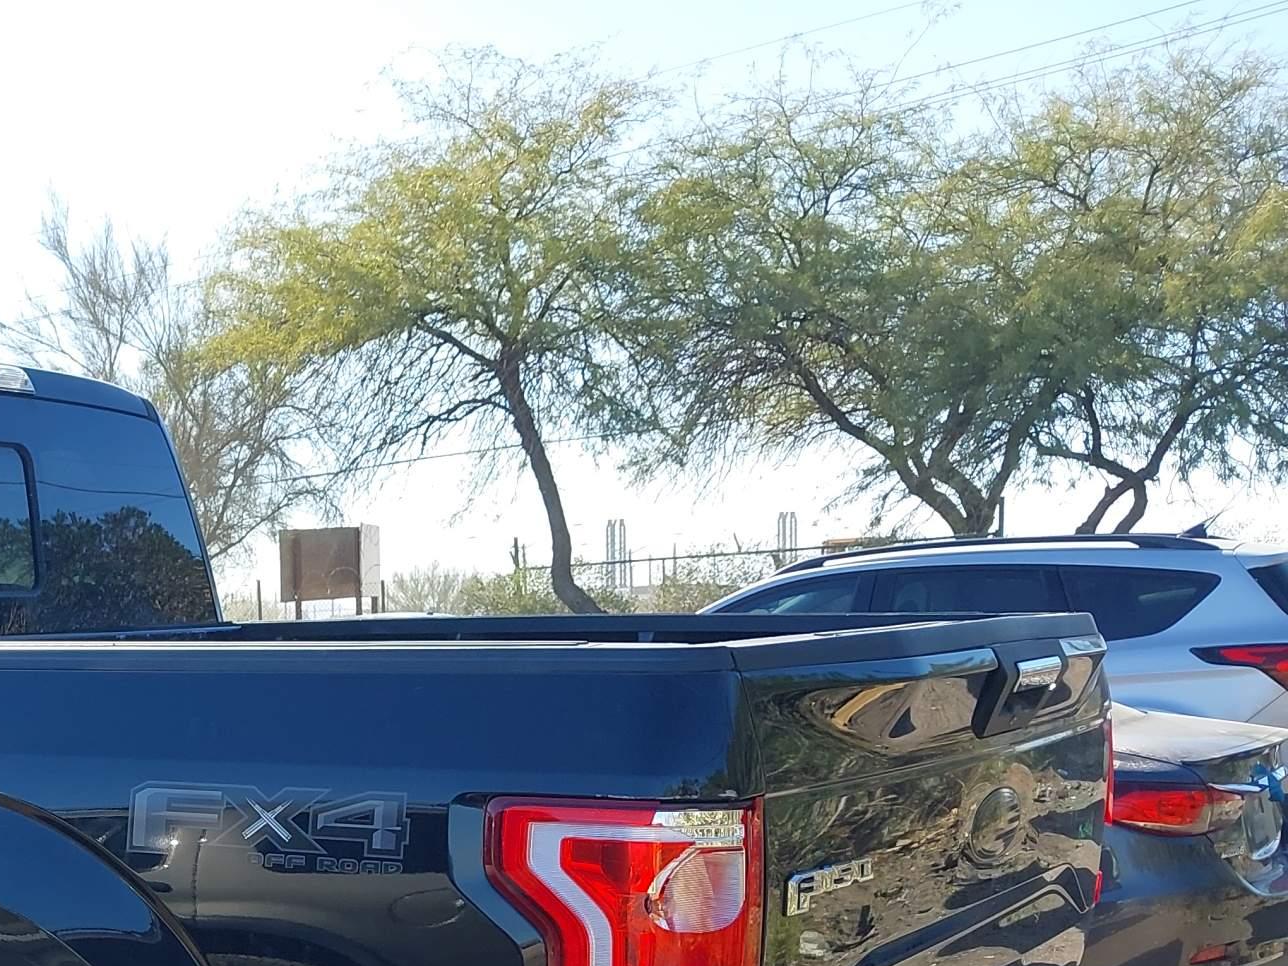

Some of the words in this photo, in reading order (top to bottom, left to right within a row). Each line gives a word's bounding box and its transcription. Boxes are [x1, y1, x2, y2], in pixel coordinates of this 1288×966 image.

[126, 780, 410, 859] FX4
[247, 852, 306, 870] OFF
[316, 857, 404, 876] ROAD
[784, 858, 874, 916] F150
